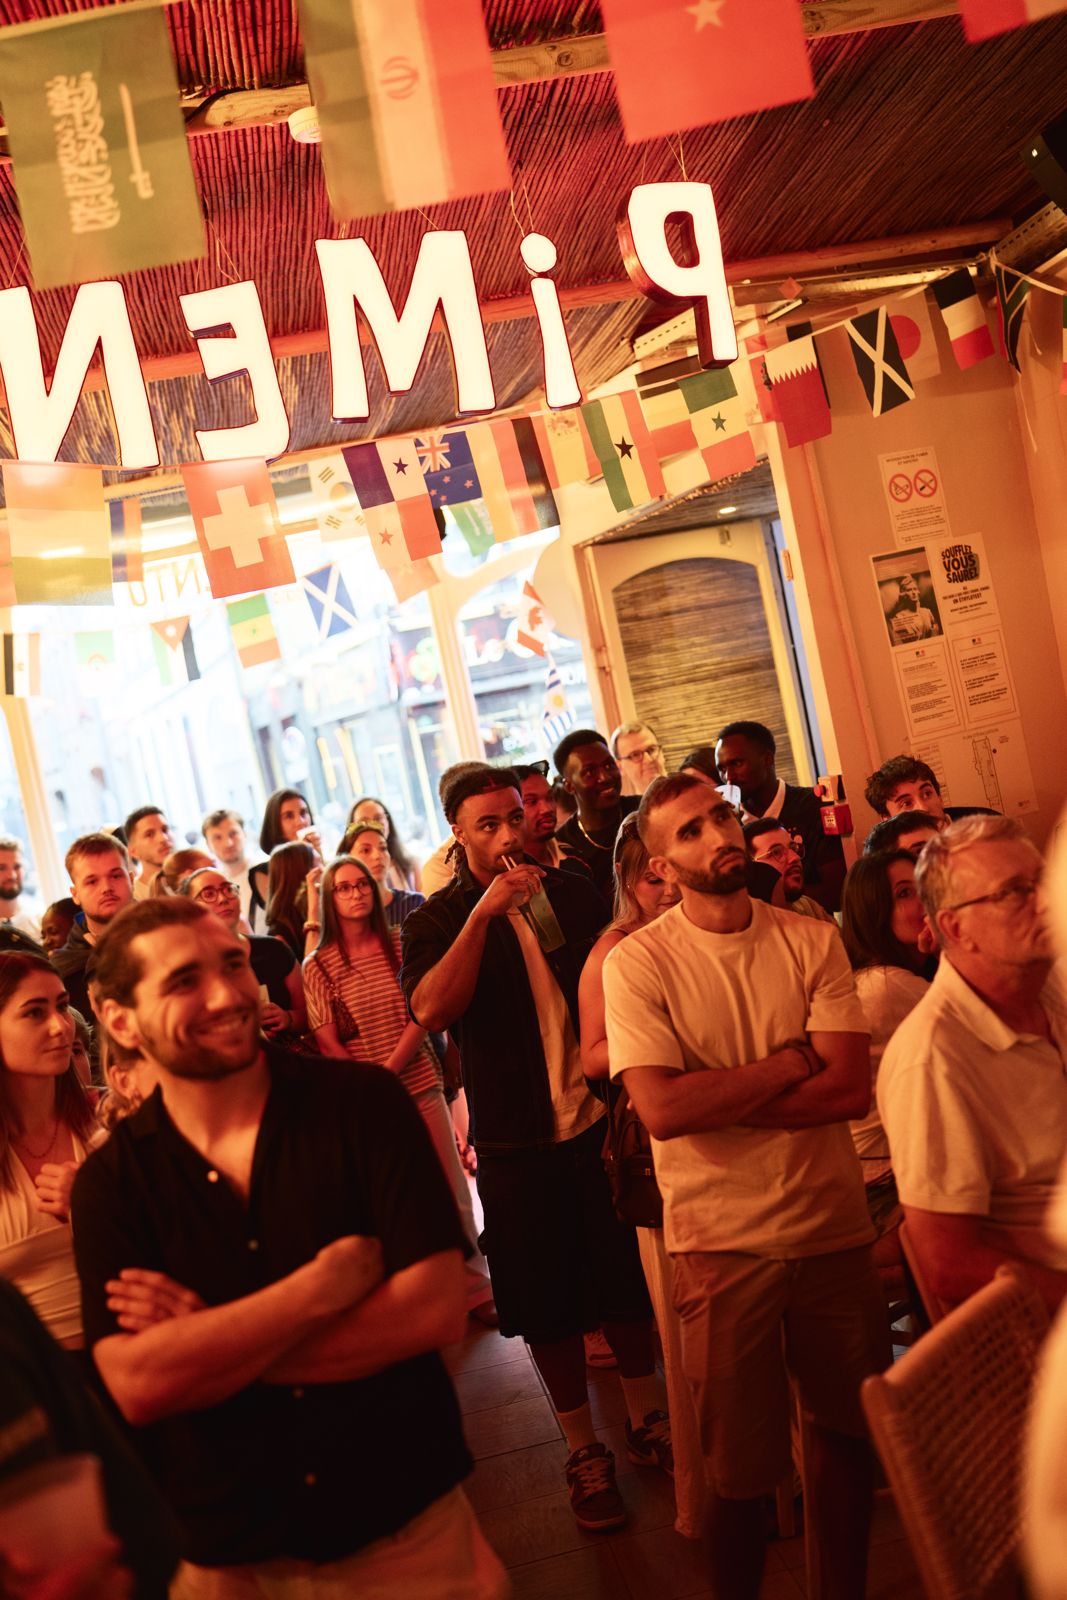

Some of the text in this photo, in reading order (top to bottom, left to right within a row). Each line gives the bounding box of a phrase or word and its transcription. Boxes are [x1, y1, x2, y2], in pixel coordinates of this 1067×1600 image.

[941, 544, 973, 560] SOUFFLEZ
[943, 554, 976, 573] VOUS
[946, 567, 979, 584] SAUREZ
